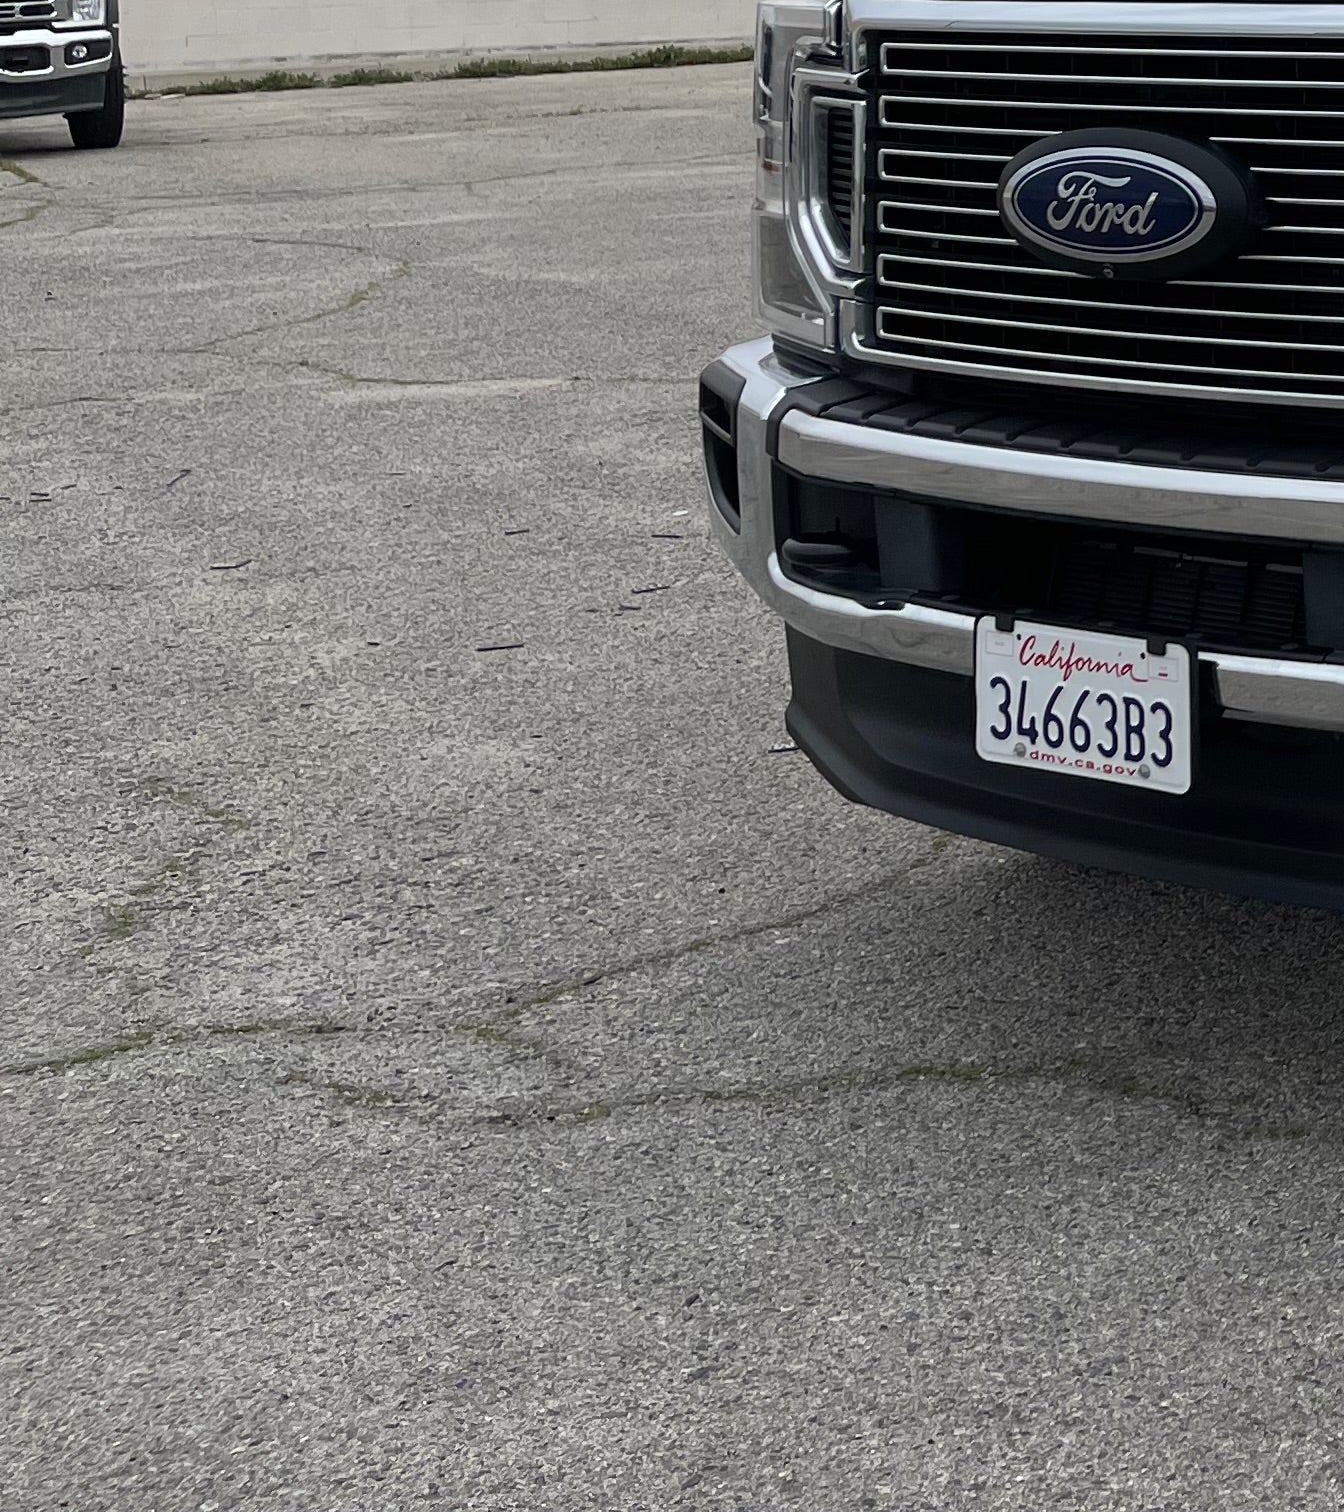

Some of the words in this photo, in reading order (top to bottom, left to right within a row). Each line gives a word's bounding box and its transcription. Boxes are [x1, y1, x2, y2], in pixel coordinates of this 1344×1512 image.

[1046, 170, 1160, 236] Ford
[1019, 635, 1149, 682] California
[990, 675, 1174, 769] 34663B3
[1029, 749, 1137, 777] dmv.ca.gov
